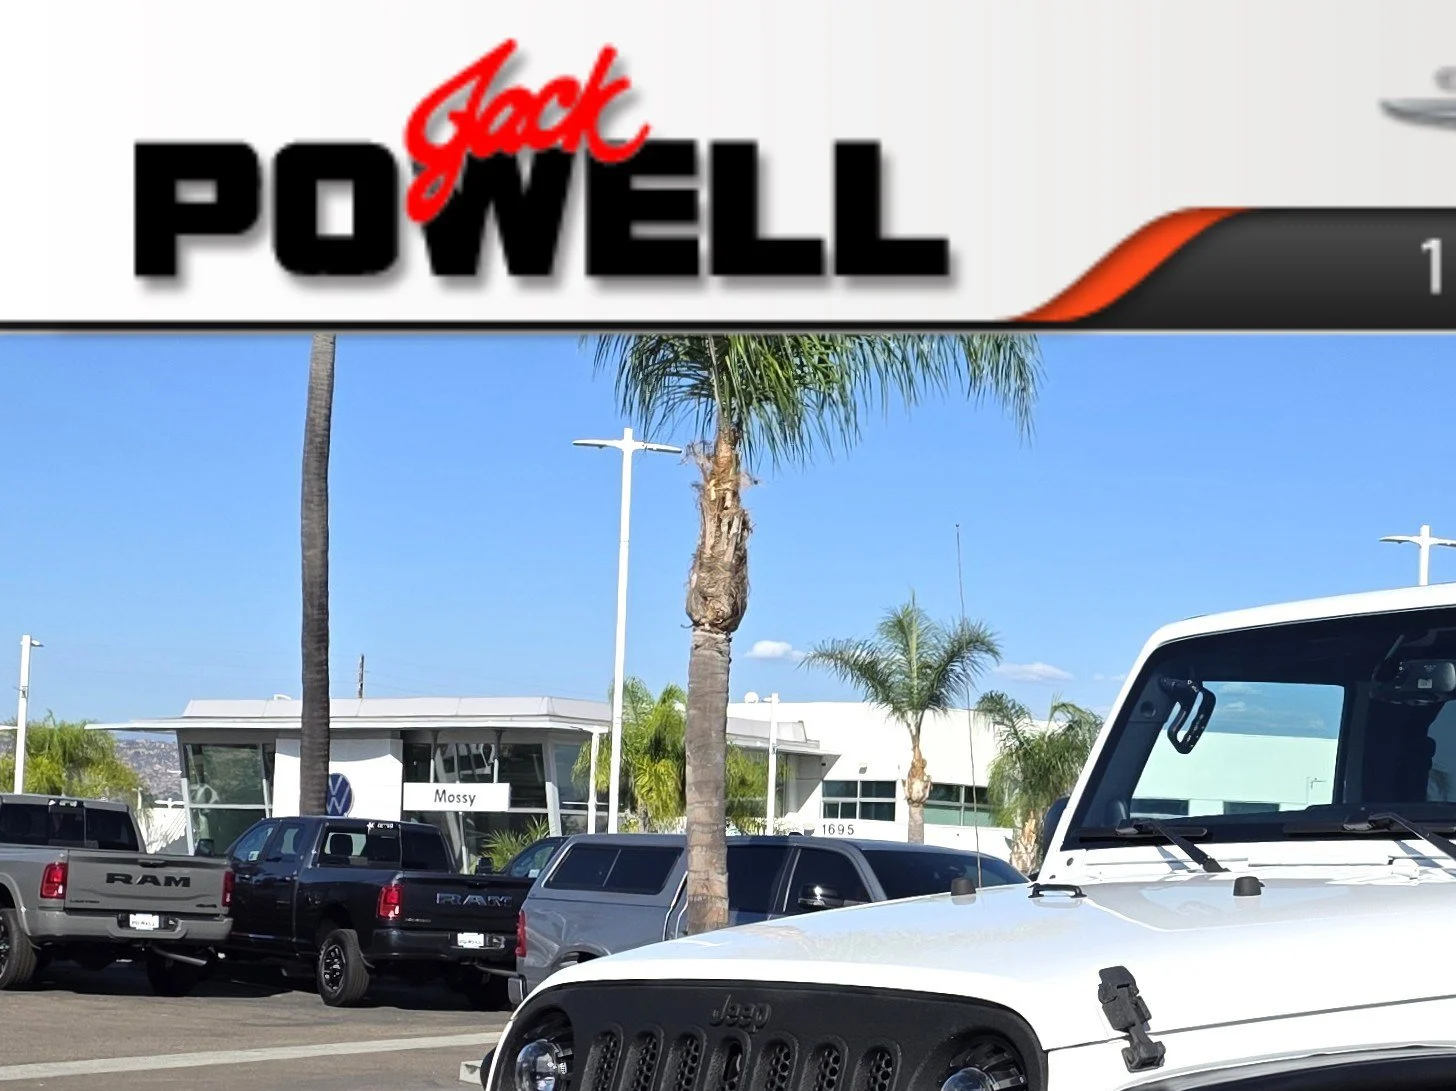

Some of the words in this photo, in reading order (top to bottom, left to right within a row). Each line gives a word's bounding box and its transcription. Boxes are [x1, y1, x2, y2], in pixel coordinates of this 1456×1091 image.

[434, 788, 476, 807] Mossy
[822, 823, 855, 836] 1695
[105, 872, 191, 888] RAM
[436, 892, 513, 908] RAM
[709, 994, 772, 1036] Jeep
